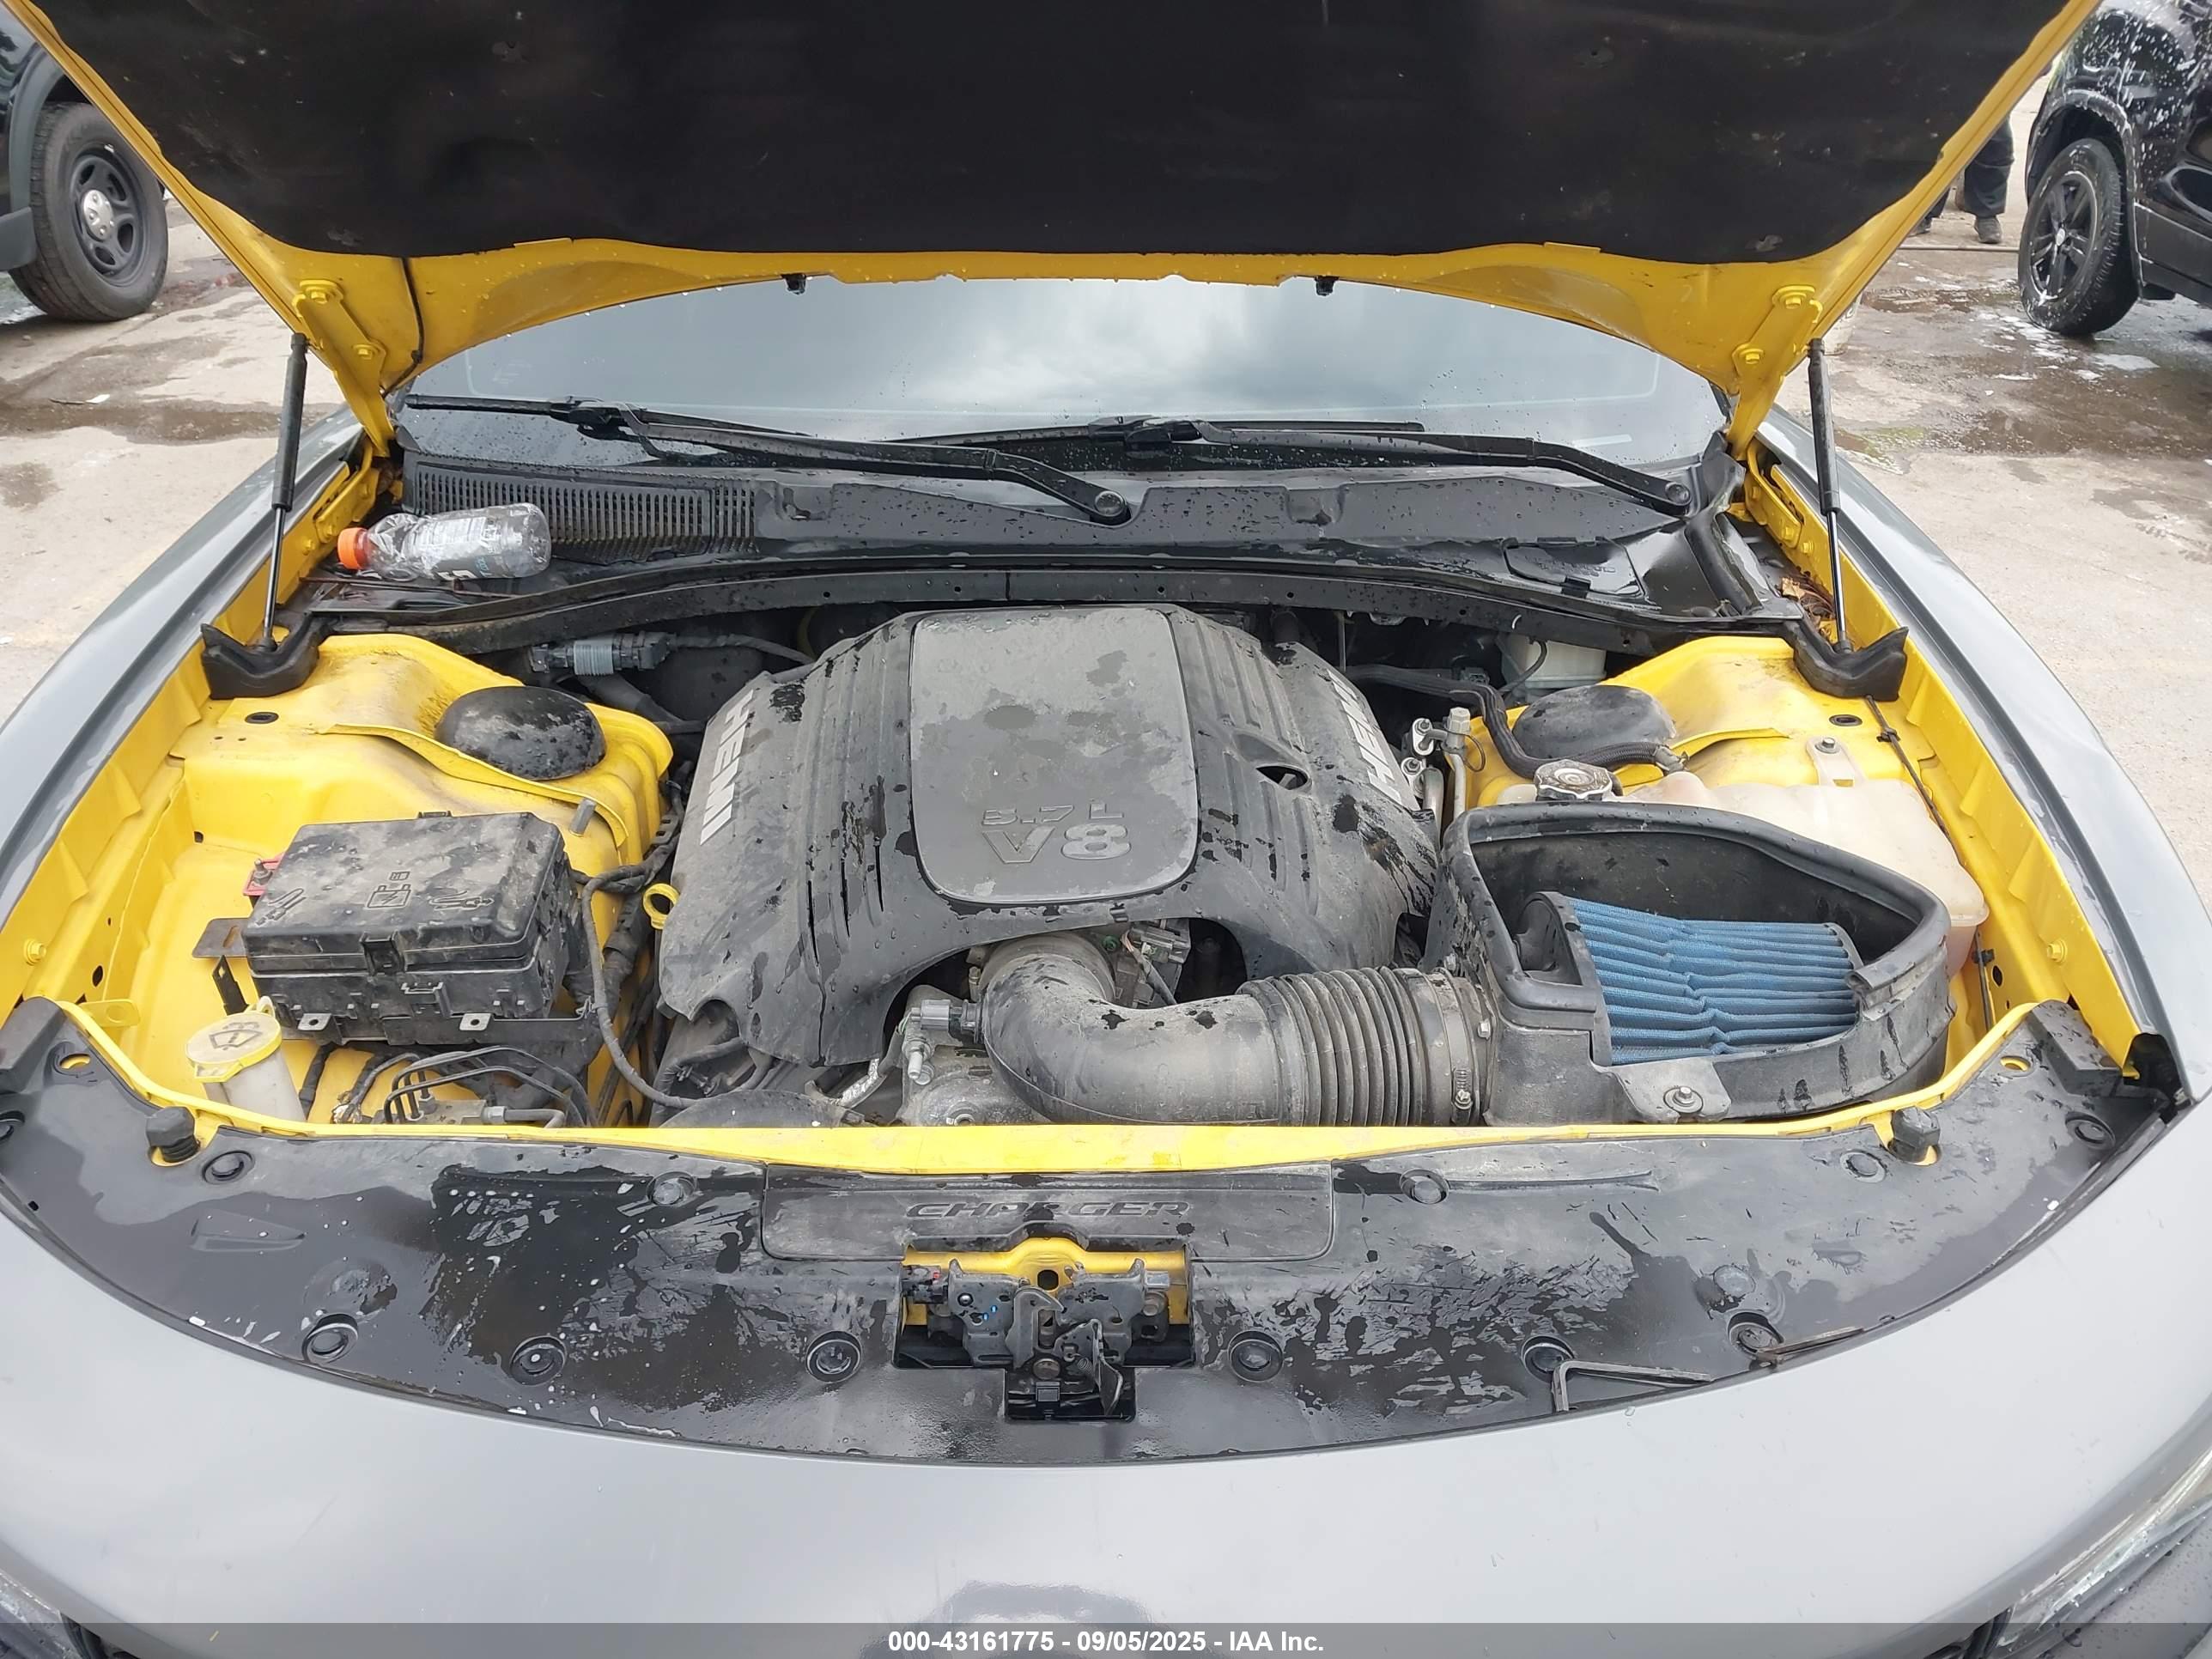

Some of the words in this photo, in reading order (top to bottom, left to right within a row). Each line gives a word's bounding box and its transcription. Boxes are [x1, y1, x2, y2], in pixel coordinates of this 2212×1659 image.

[699, 689, 754, 846] HEMI
[1327, 668, 1402, 805] HEMI
[981, 823, 1132, 864] V8
